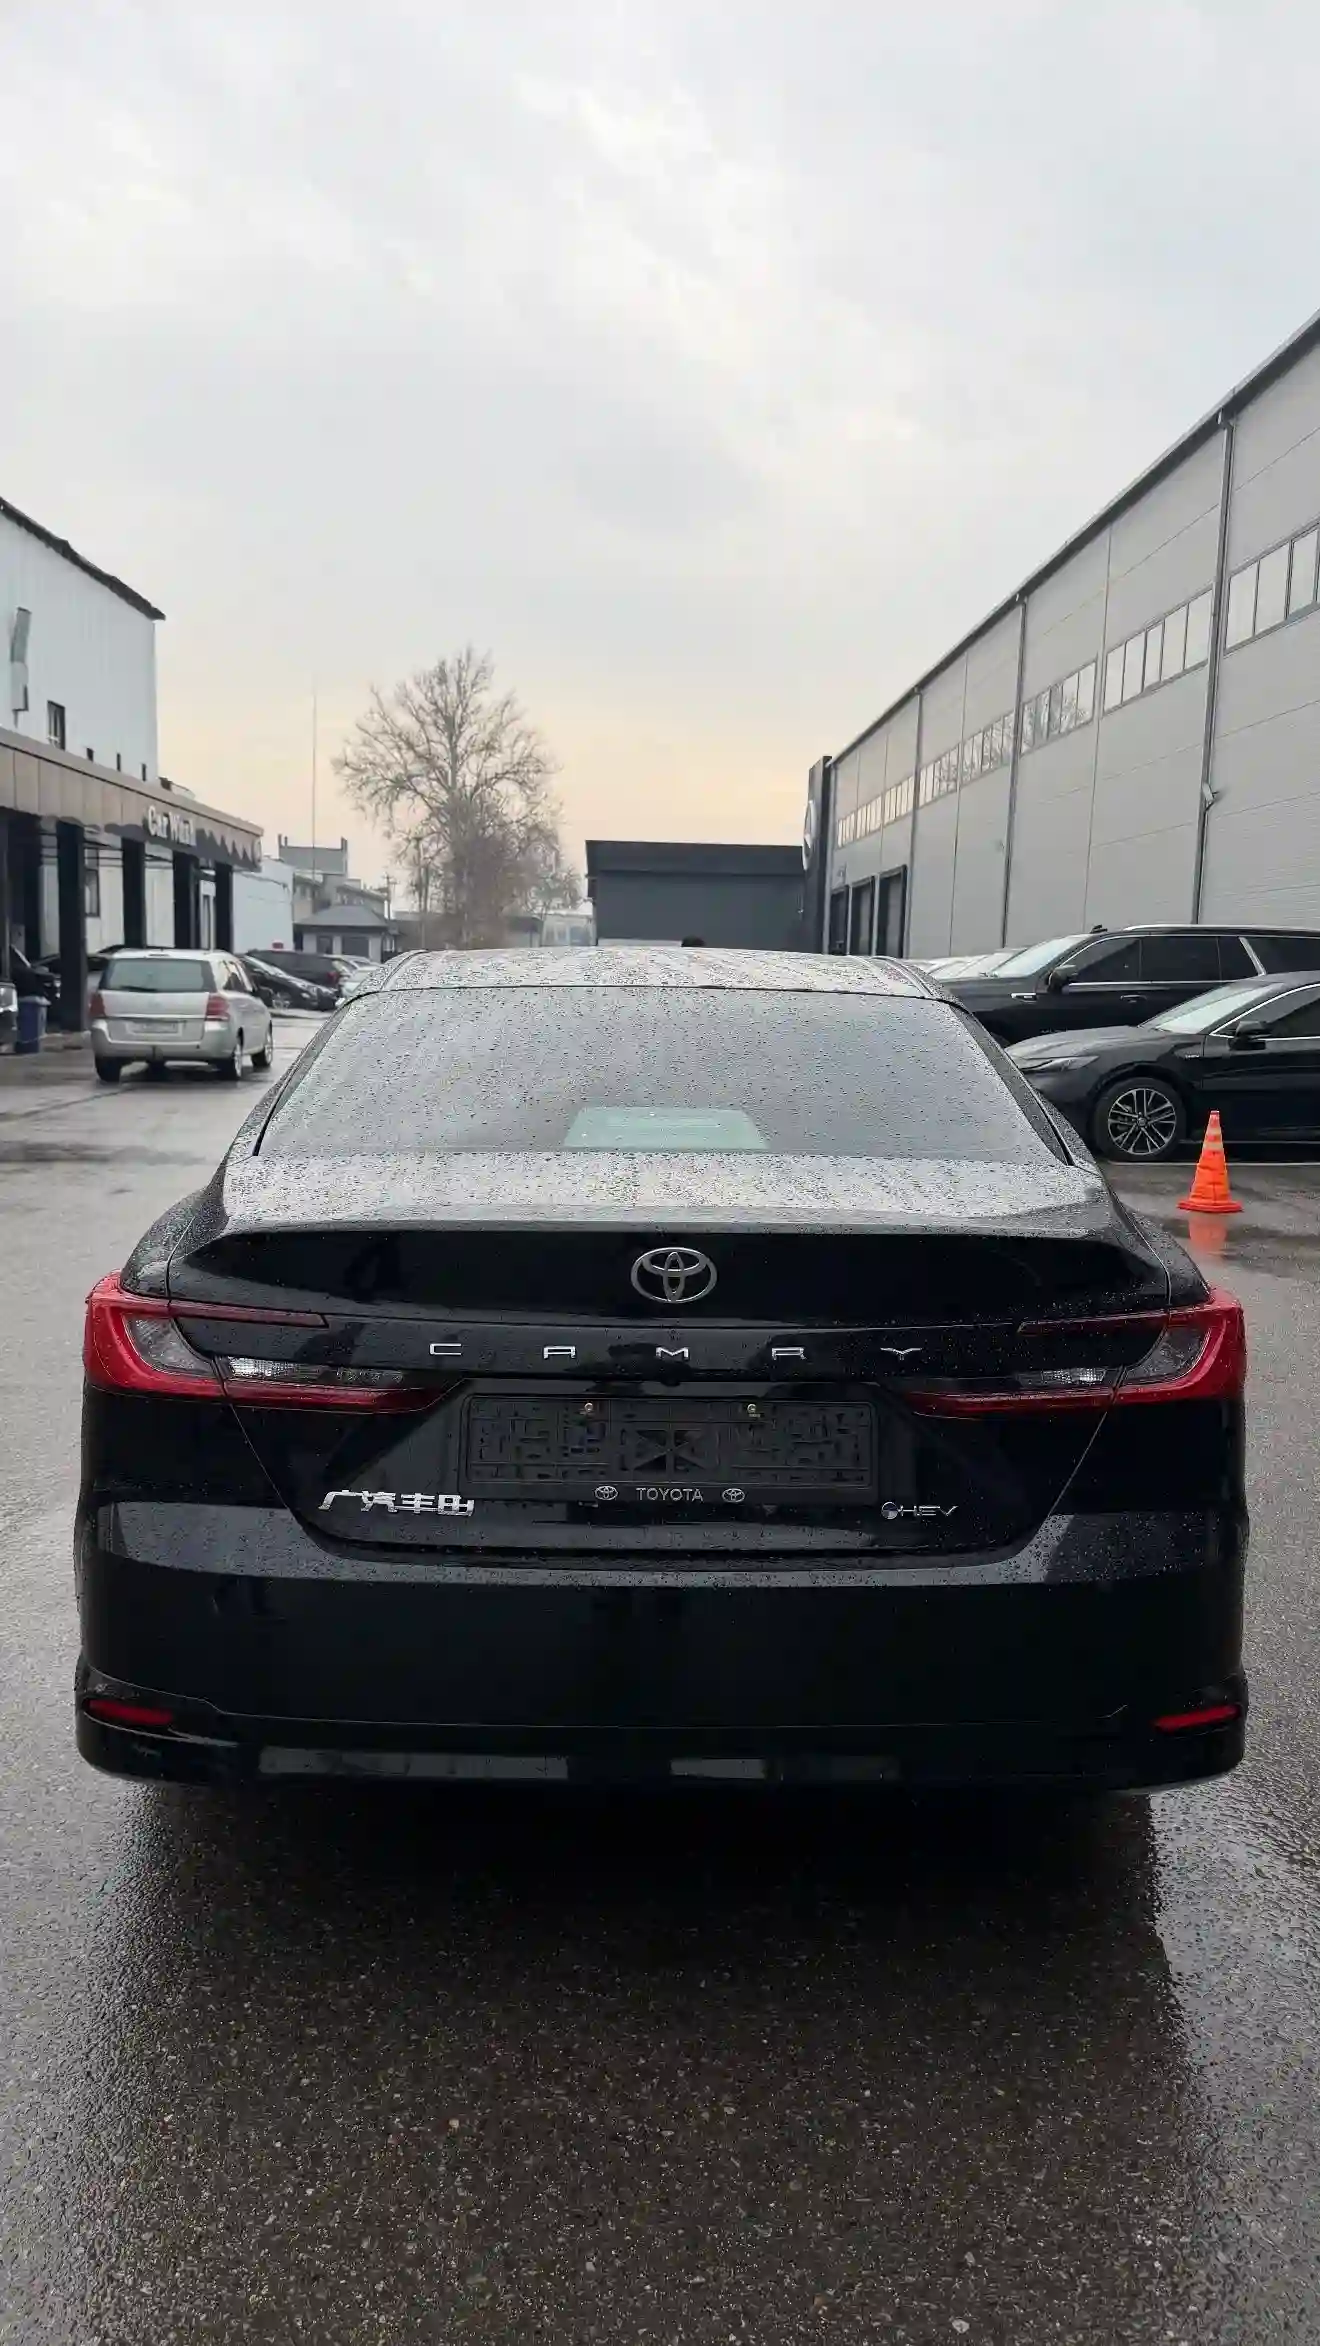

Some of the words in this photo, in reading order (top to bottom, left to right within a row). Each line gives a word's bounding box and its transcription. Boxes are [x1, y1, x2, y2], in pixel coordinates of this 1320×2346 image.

[148, 805, 168, 839] Car
[429, 1342, 922, 1361] CAMRY
[318, 1489, 475, 1516] 广汽丰田
[636, 1487, 704, 1502] TOYOTA
[900, 1505, 959, 1517] HEV
